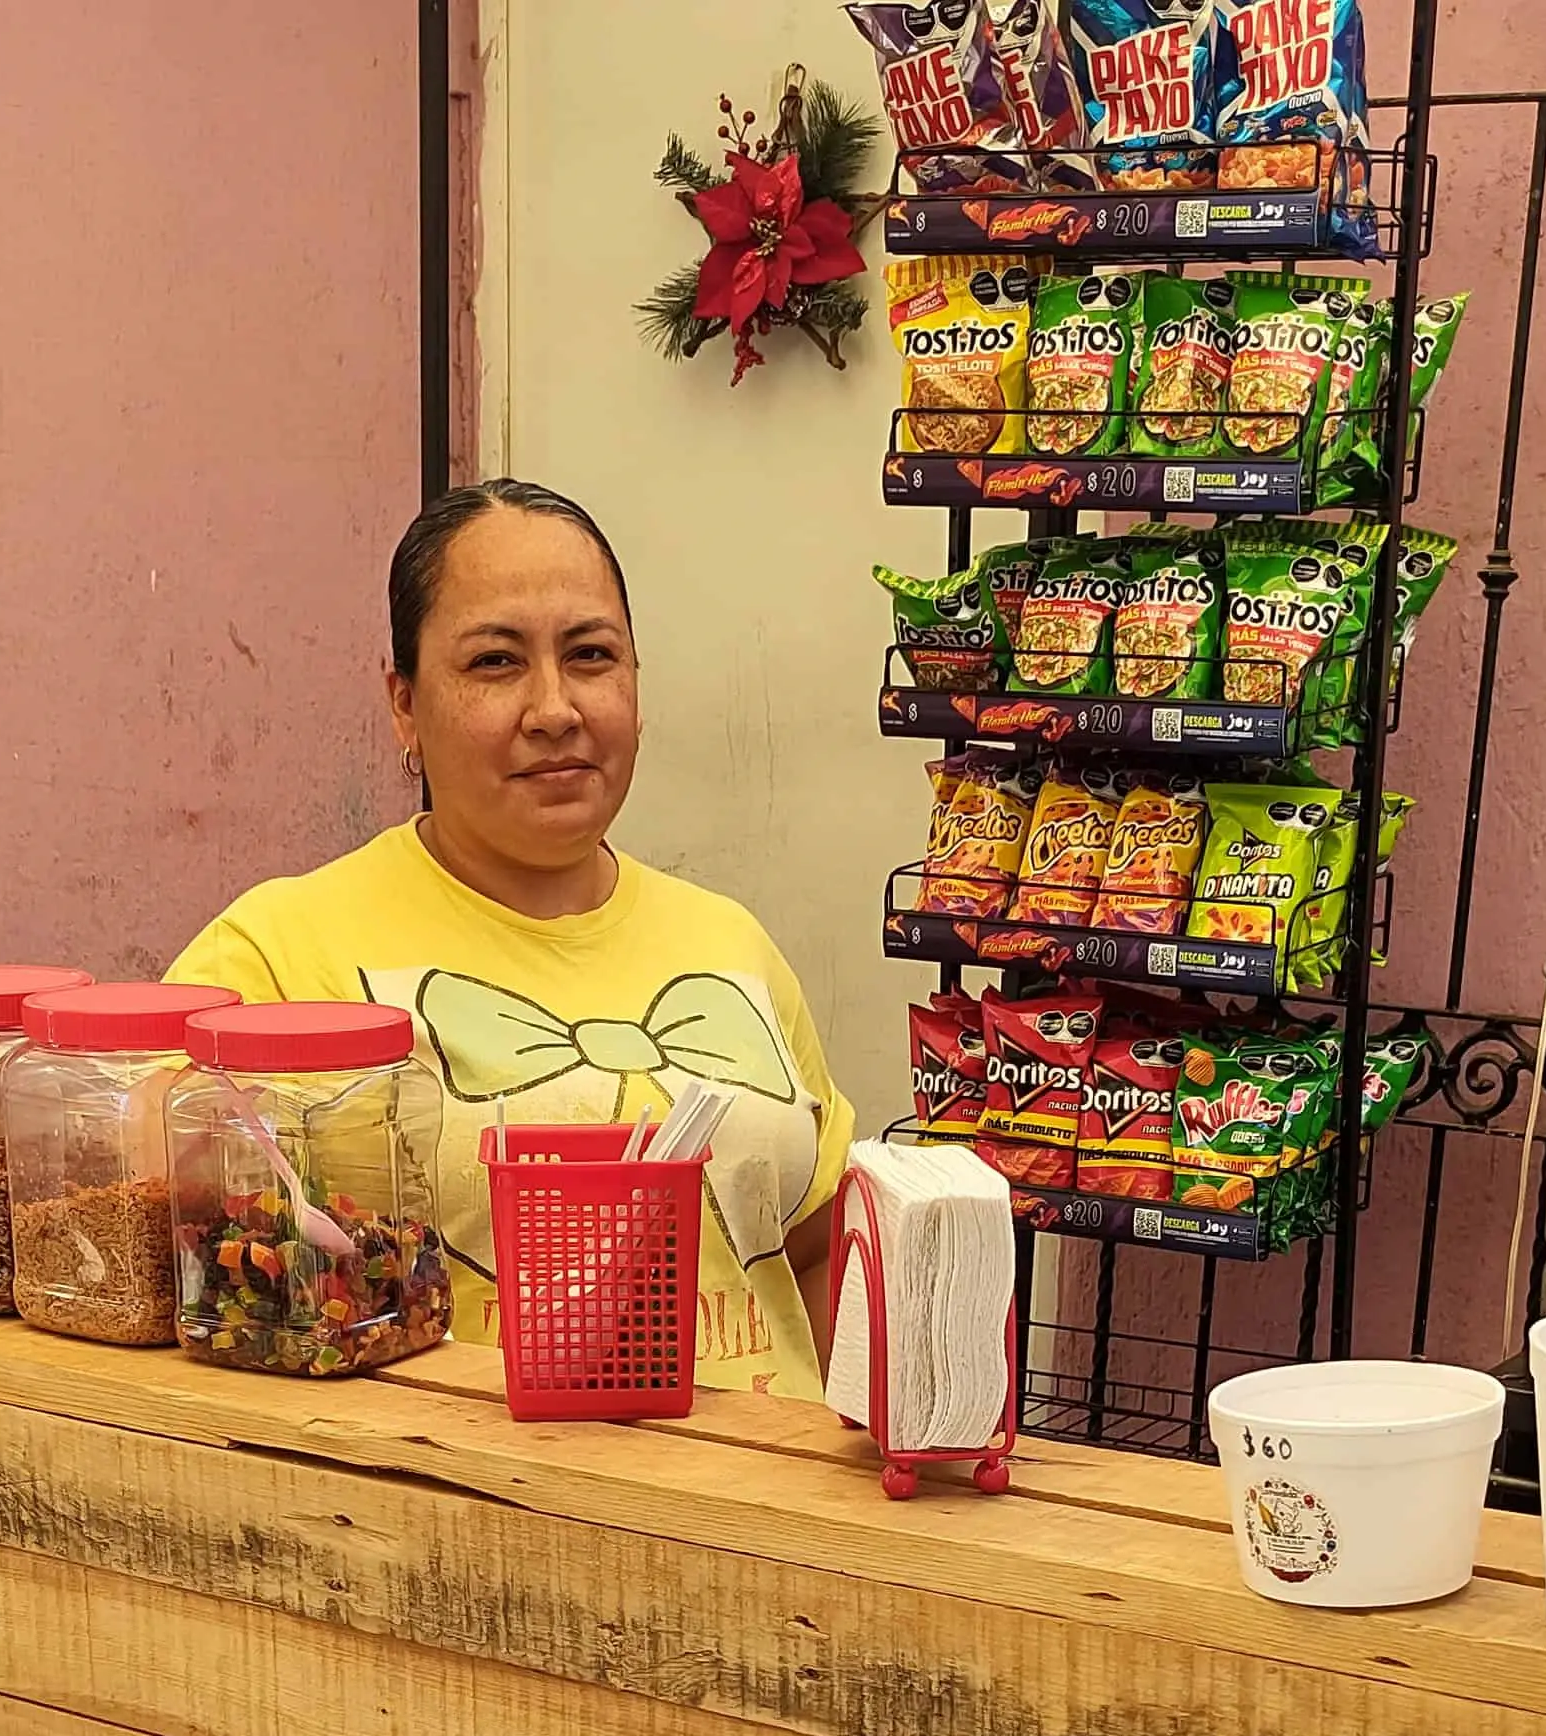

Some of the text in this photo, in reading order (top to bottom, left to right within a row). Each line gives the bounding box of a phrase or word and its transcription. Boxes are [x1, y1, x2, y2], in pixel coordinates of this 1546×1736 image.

[1230, 0, 1330, 57] PAKE
[1091, 26, 1191, 92] PAKE
[1240, 40, 1327, 110] TAXO
[887, 50, 960, 107] AKE
[1099, 82, 1191, 139] TAXO
[1255, 201, 1285, 219] joy
[914, 359, 994, 374] TOSTI-ELOTE
[1240, 470, 1268, 488] joy
[1030, 573, 1126, 608] OSTITOS
[1123, 569, 1214, 606] OSTITOS
[1226, 713, 1253, 731] joy
[933, 805, 1022, 859] Cheetos
[1227, 842, 1282, 859] Doritos
[1203, 874, 1294, 898] DINAMITA
[1220, 951, 1246, 970] joy
[912, 1066, 987, 1098] Doritos
[986, 1056, 1082, 1090] Doritos
[1080, 1084, 1172, 1113] Doritos
[1178, 1080, 1285, 1146] Ruffles
[1204, 1219, 1228, 1236] joy
